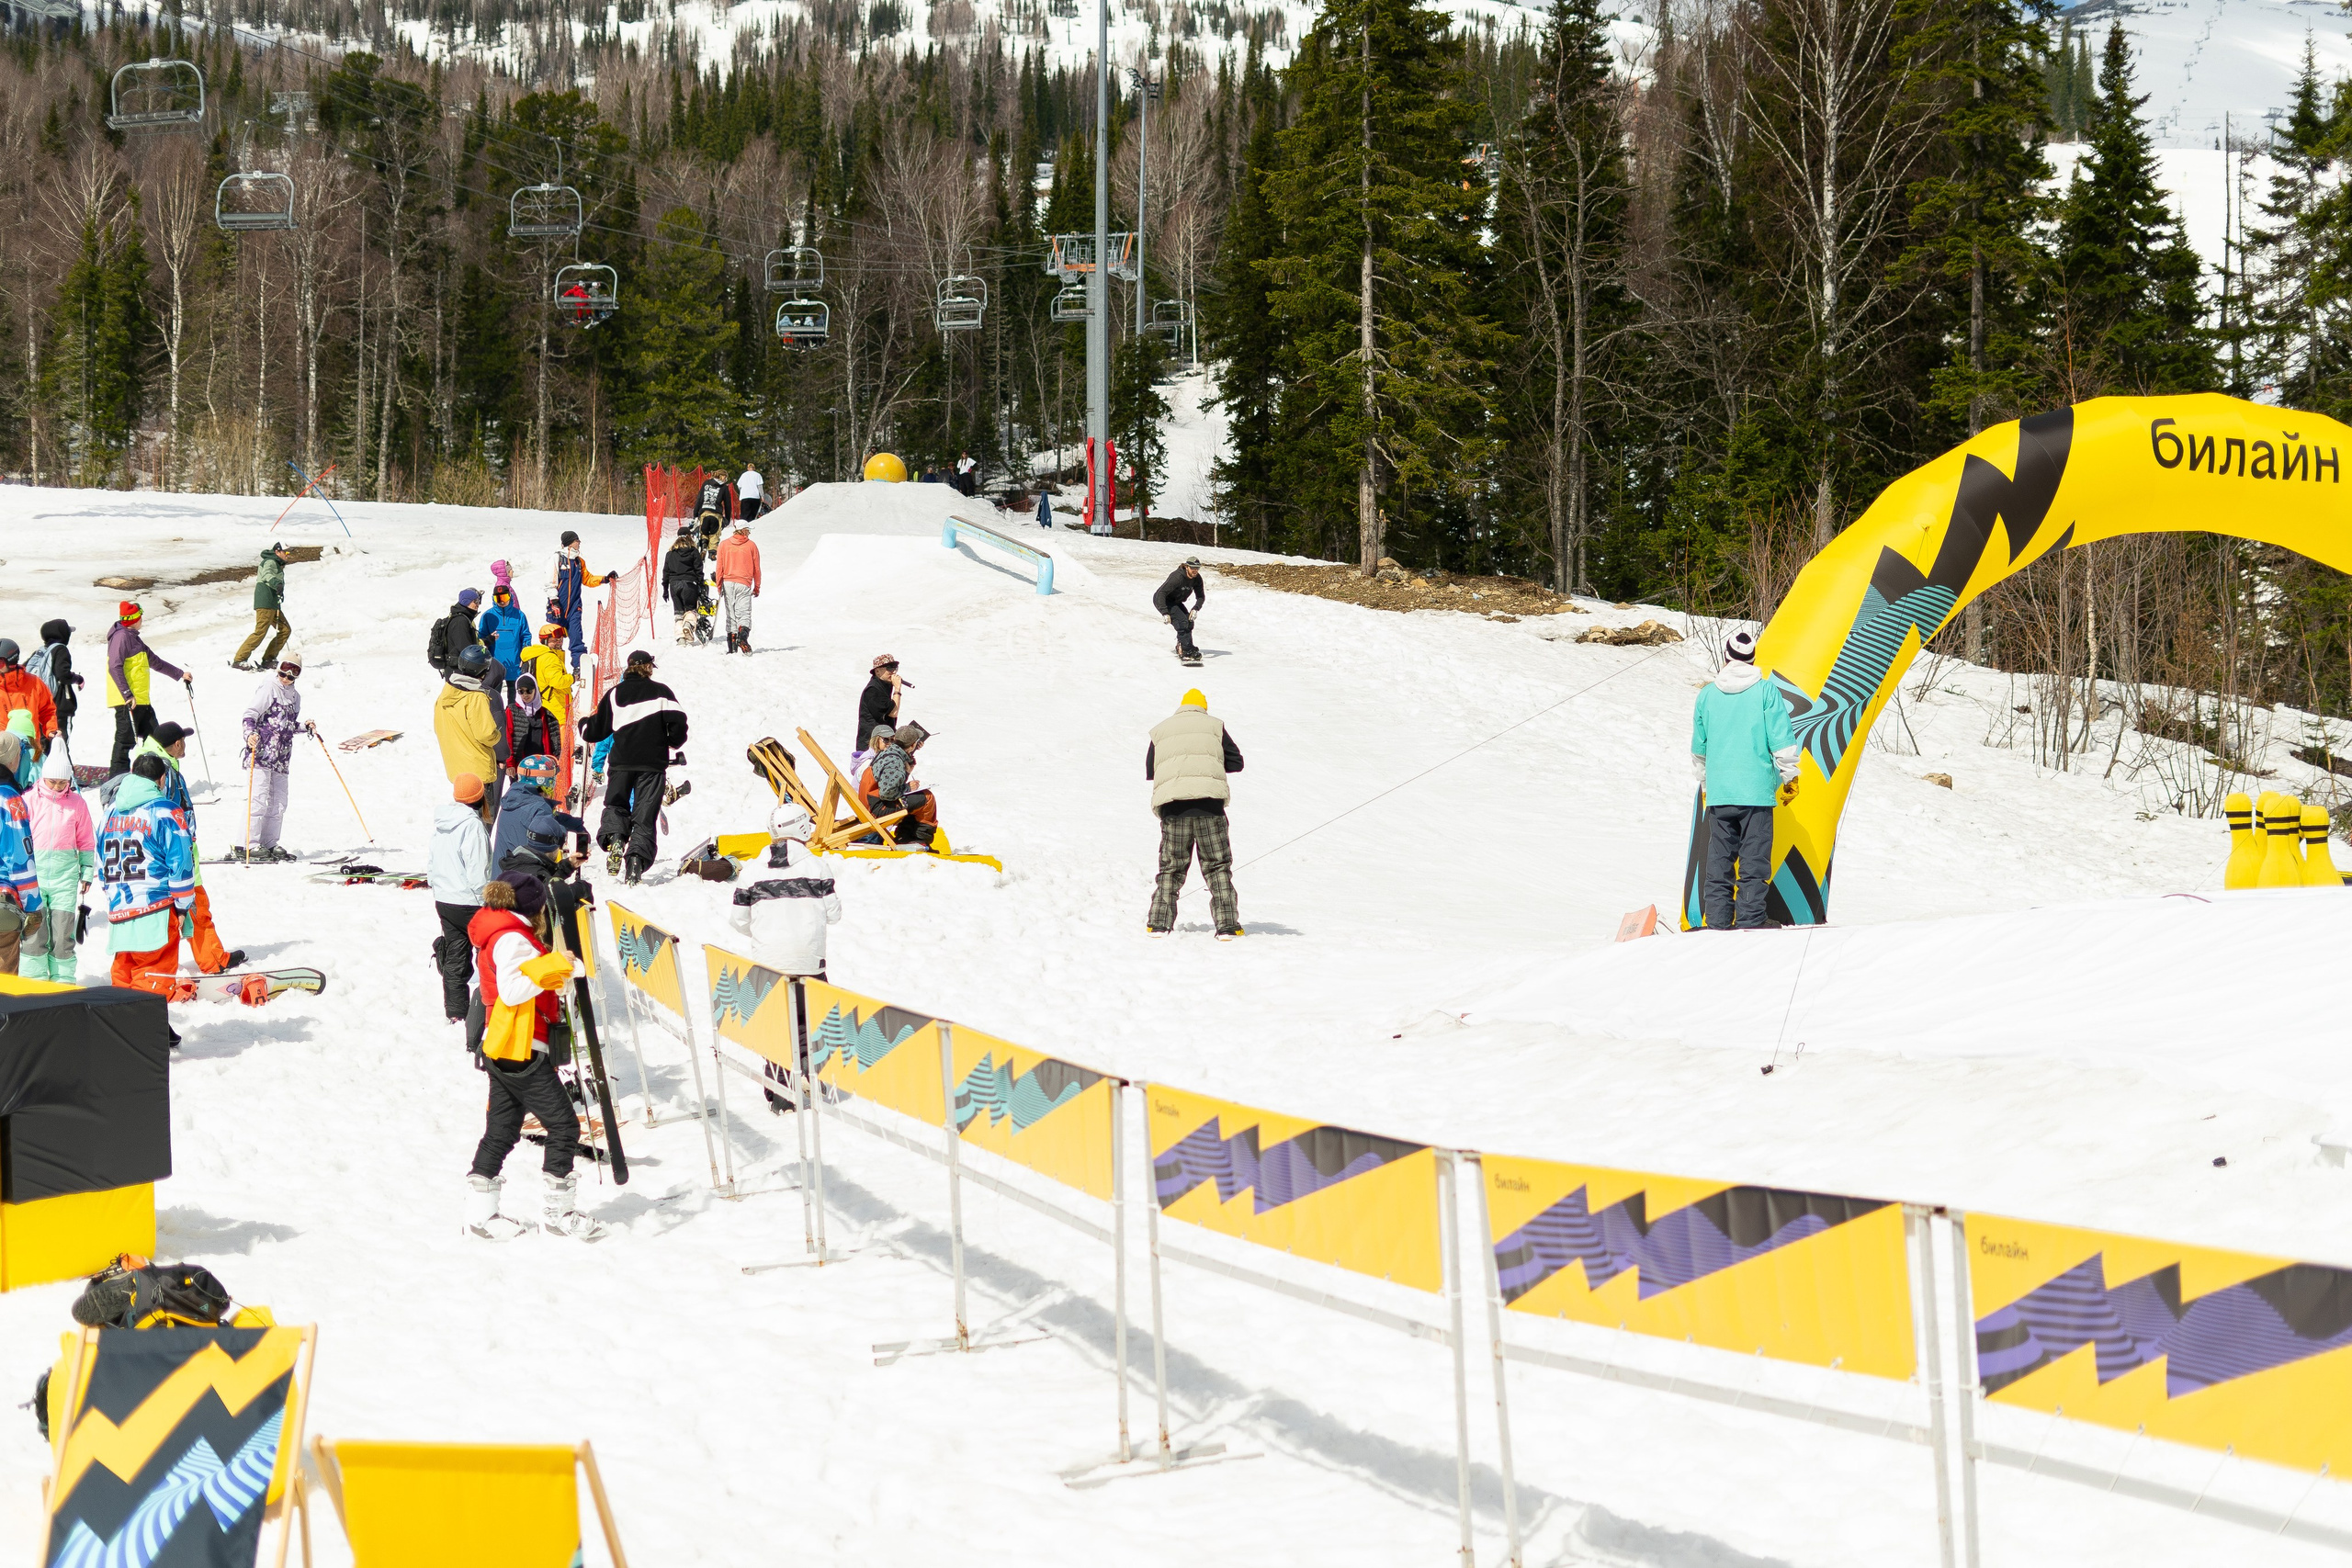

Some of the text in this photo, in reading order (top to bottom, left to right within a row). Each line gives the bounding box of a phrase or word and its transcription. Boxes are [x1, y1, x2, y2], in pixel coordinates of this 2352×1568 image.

[2151, 417, 2339, 483] билайн
[105, 817, 152, 837] ОЦМАН
[104, 838, 146, 883] 22
[1494, 1173, 1530, 1192] билайн
[1980, 1235, 2030, 1261] билайн
